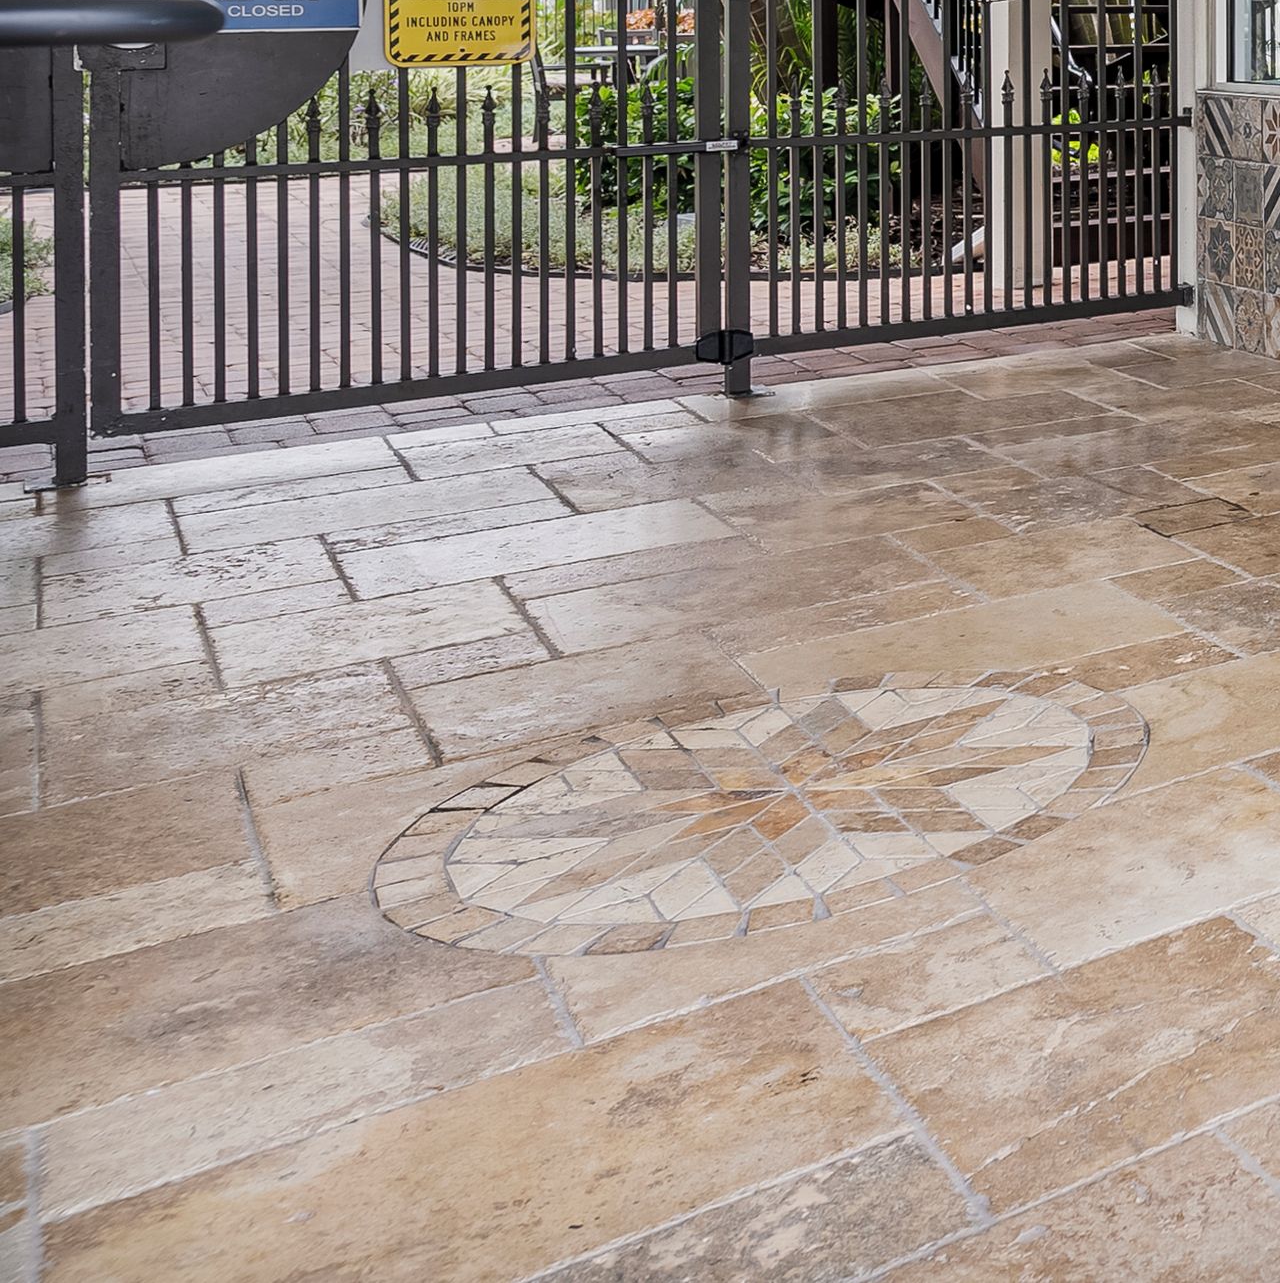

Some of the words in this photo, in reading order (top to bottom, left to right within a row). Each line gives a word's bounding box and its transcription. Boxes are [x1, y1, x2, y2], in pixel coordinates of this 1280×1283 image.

[227, 5, 304, 17] CLOSED
[447, 2, 475, 12] 10PM
[406, 16, 467, 28] INCLUDING
[471, 16, 515, 26] CANOPY
[426, 30, 449, 42] AND
[454, 30, 496, 41] FRAMES
